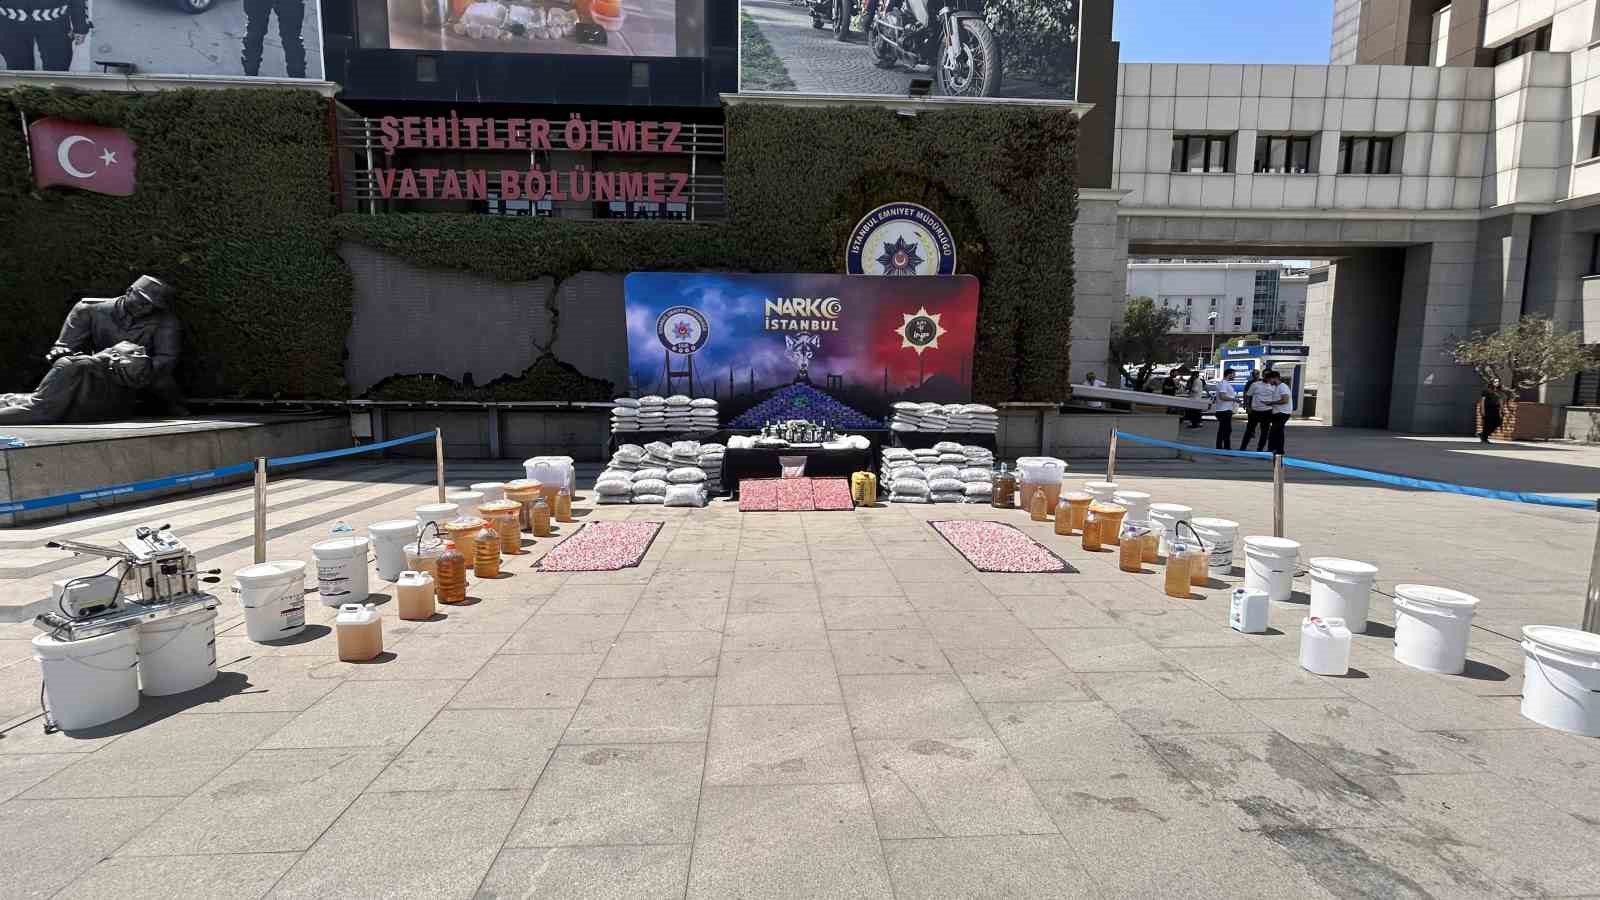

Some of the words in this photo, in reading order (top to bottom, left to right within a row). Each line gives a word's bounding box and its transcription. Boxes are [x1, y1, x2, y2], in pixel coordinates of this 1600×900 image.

[380, 110, 551, 155] ŞEHİTLER
[565, 112, 682, 152] ÖLMEZ
[374, 168, 488, 200] VATAN
[501, 163, 688, 203] BÖLÜNMEZ
[765, 317, 839, 331] İSTANBUL
